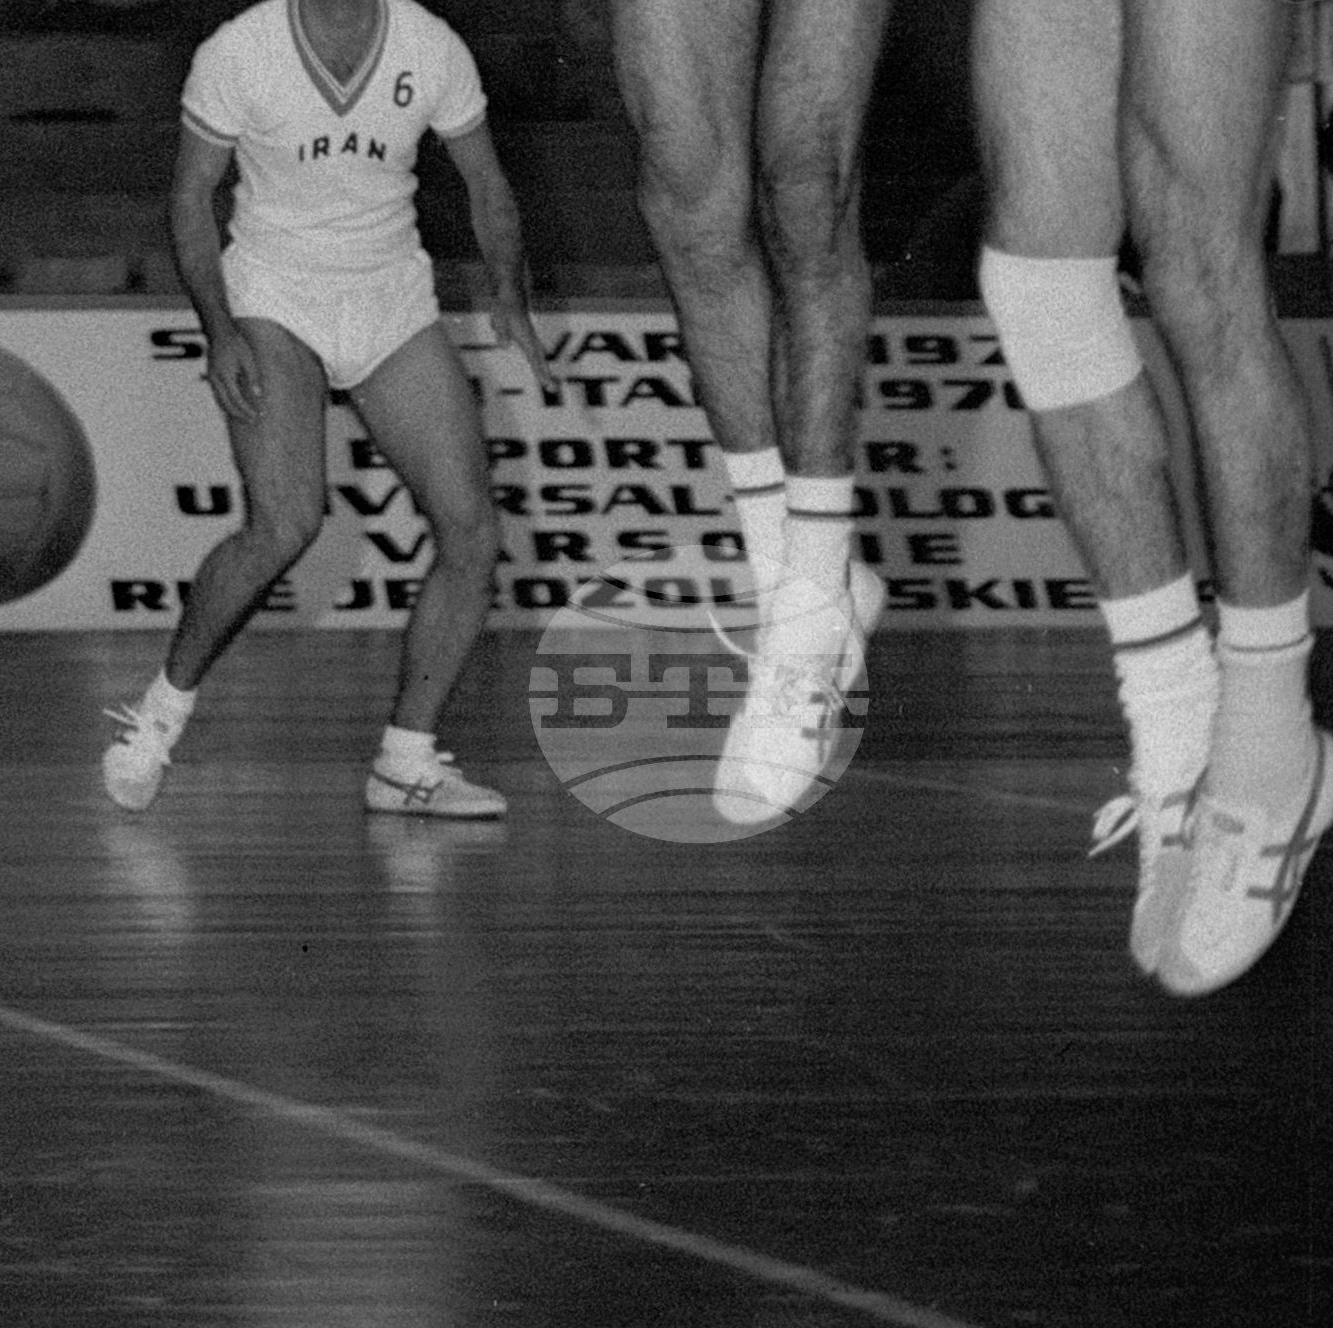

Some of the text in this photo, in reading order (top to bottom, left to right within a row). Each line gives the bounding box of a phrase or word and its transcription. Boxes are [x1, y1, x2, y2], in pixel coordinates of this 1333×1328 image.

[393, 71, 415, 108] 6
[299, 131, 387, 162] IRAN
[867, 334, 1007, 365] 197
